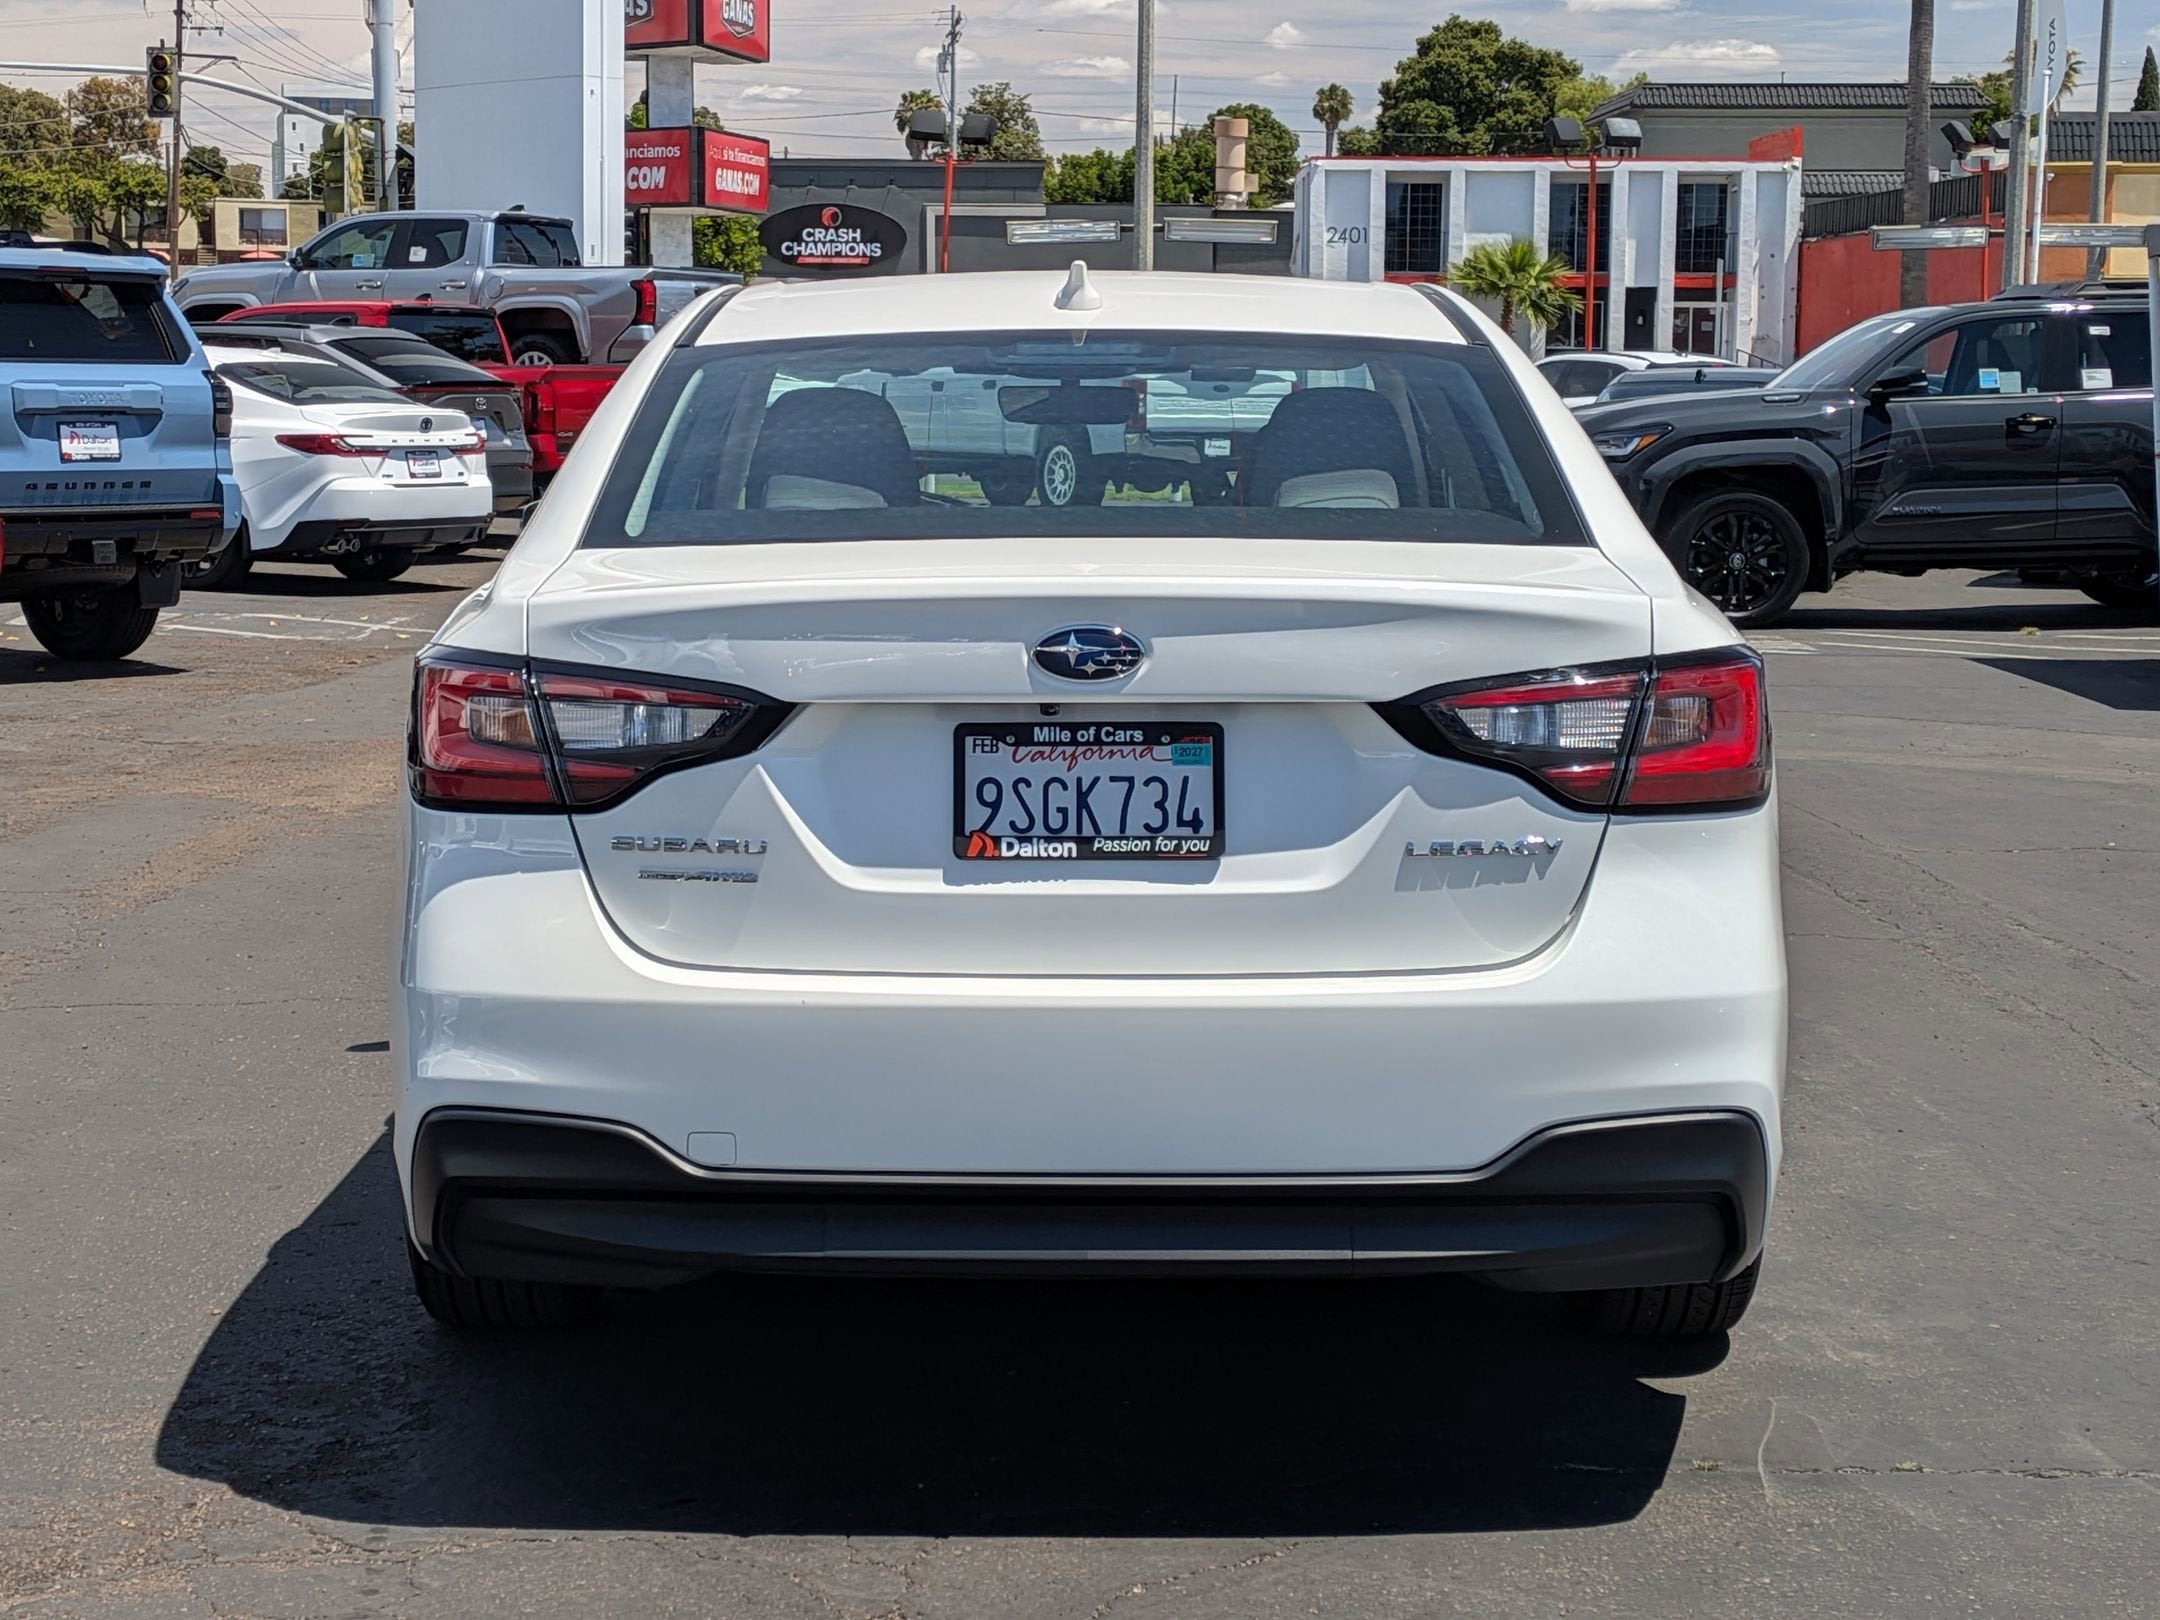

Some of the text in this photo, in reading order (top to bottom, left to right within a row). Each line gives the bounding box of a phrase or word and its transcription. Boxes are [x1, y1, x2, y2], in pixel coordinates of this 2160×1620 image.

[802, 228, 861, 242] CRASH
[1326, 226, 1367, 244] 2401
[781, 241, 882, 257] CHAMPIONS
[69, 392, 124, 405] TOYOTA
[1033, 726, 1144, 743] Mile of Cars
[972, 738, 1000, 754] FEB
[1179, 747, 1203, 757] 2027
[1011, 743, 1172, 773] California
[975, 775, 1204, 835] 9SGK734
[610, 836, 768, 855] SUBARU
[1001, 837, 1077, 858] Dalton
[1093, 837, 1210, 856] Passion for you
[1406, 837, 1564, 857] LEGACY
